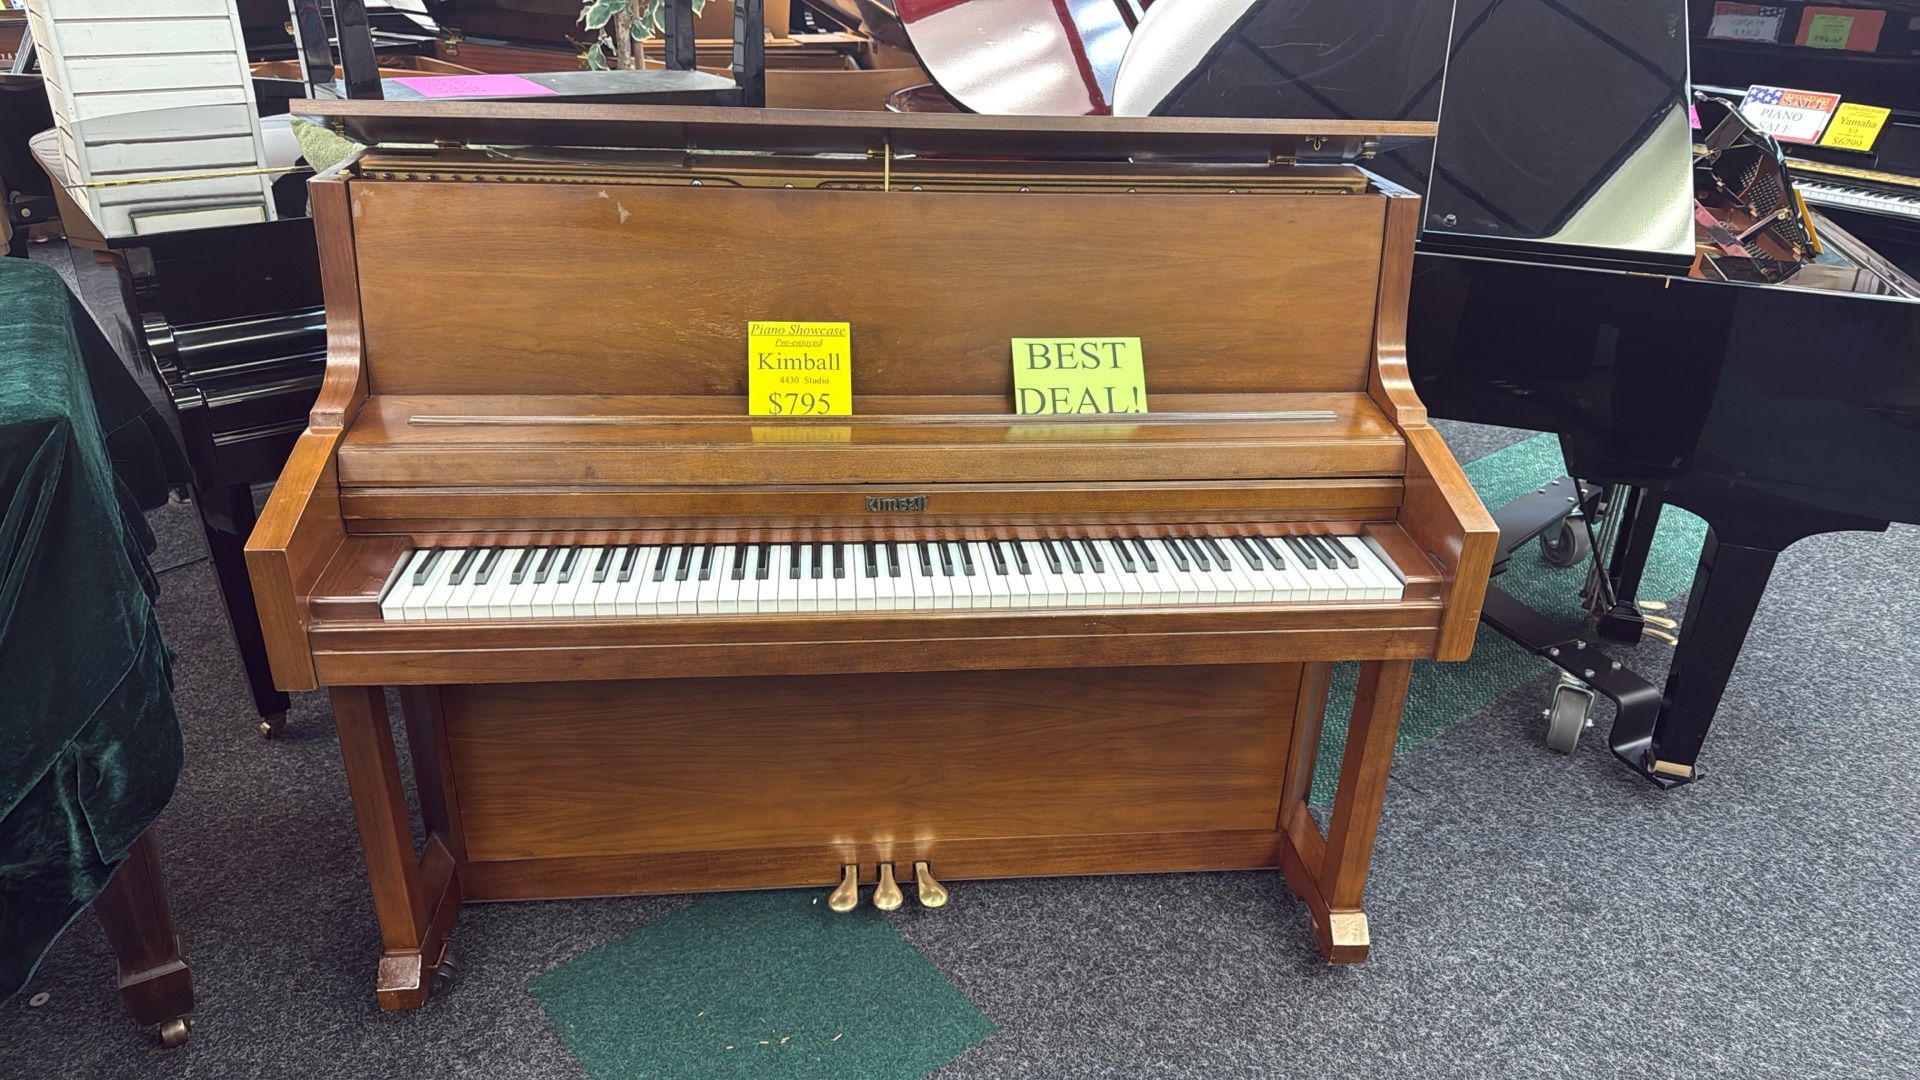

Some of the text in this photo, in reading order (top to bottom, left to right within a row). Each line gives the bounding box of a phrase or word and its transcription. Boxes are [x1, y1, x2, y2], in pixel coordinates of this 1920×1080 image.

[1760, 108, 1803, 122] PIANO
[1758, 121, 1790, 134] SALE
[1840, 116, 1877, 129] Yamaha
[1831, 136, 1863, 148] $6799
[750, 323, 847, 337] Piano Showcase
[774, 338, 824, 348] Pre-enjoyed
[757, 352, 841, 371] Kimball
[1024, 342, 1127, 370] BEST
[779, 376, 830, 385] 4430 Studio
[768, 391, 831, 416] $795
[1016, 386, 1141, 415] DEAL!
